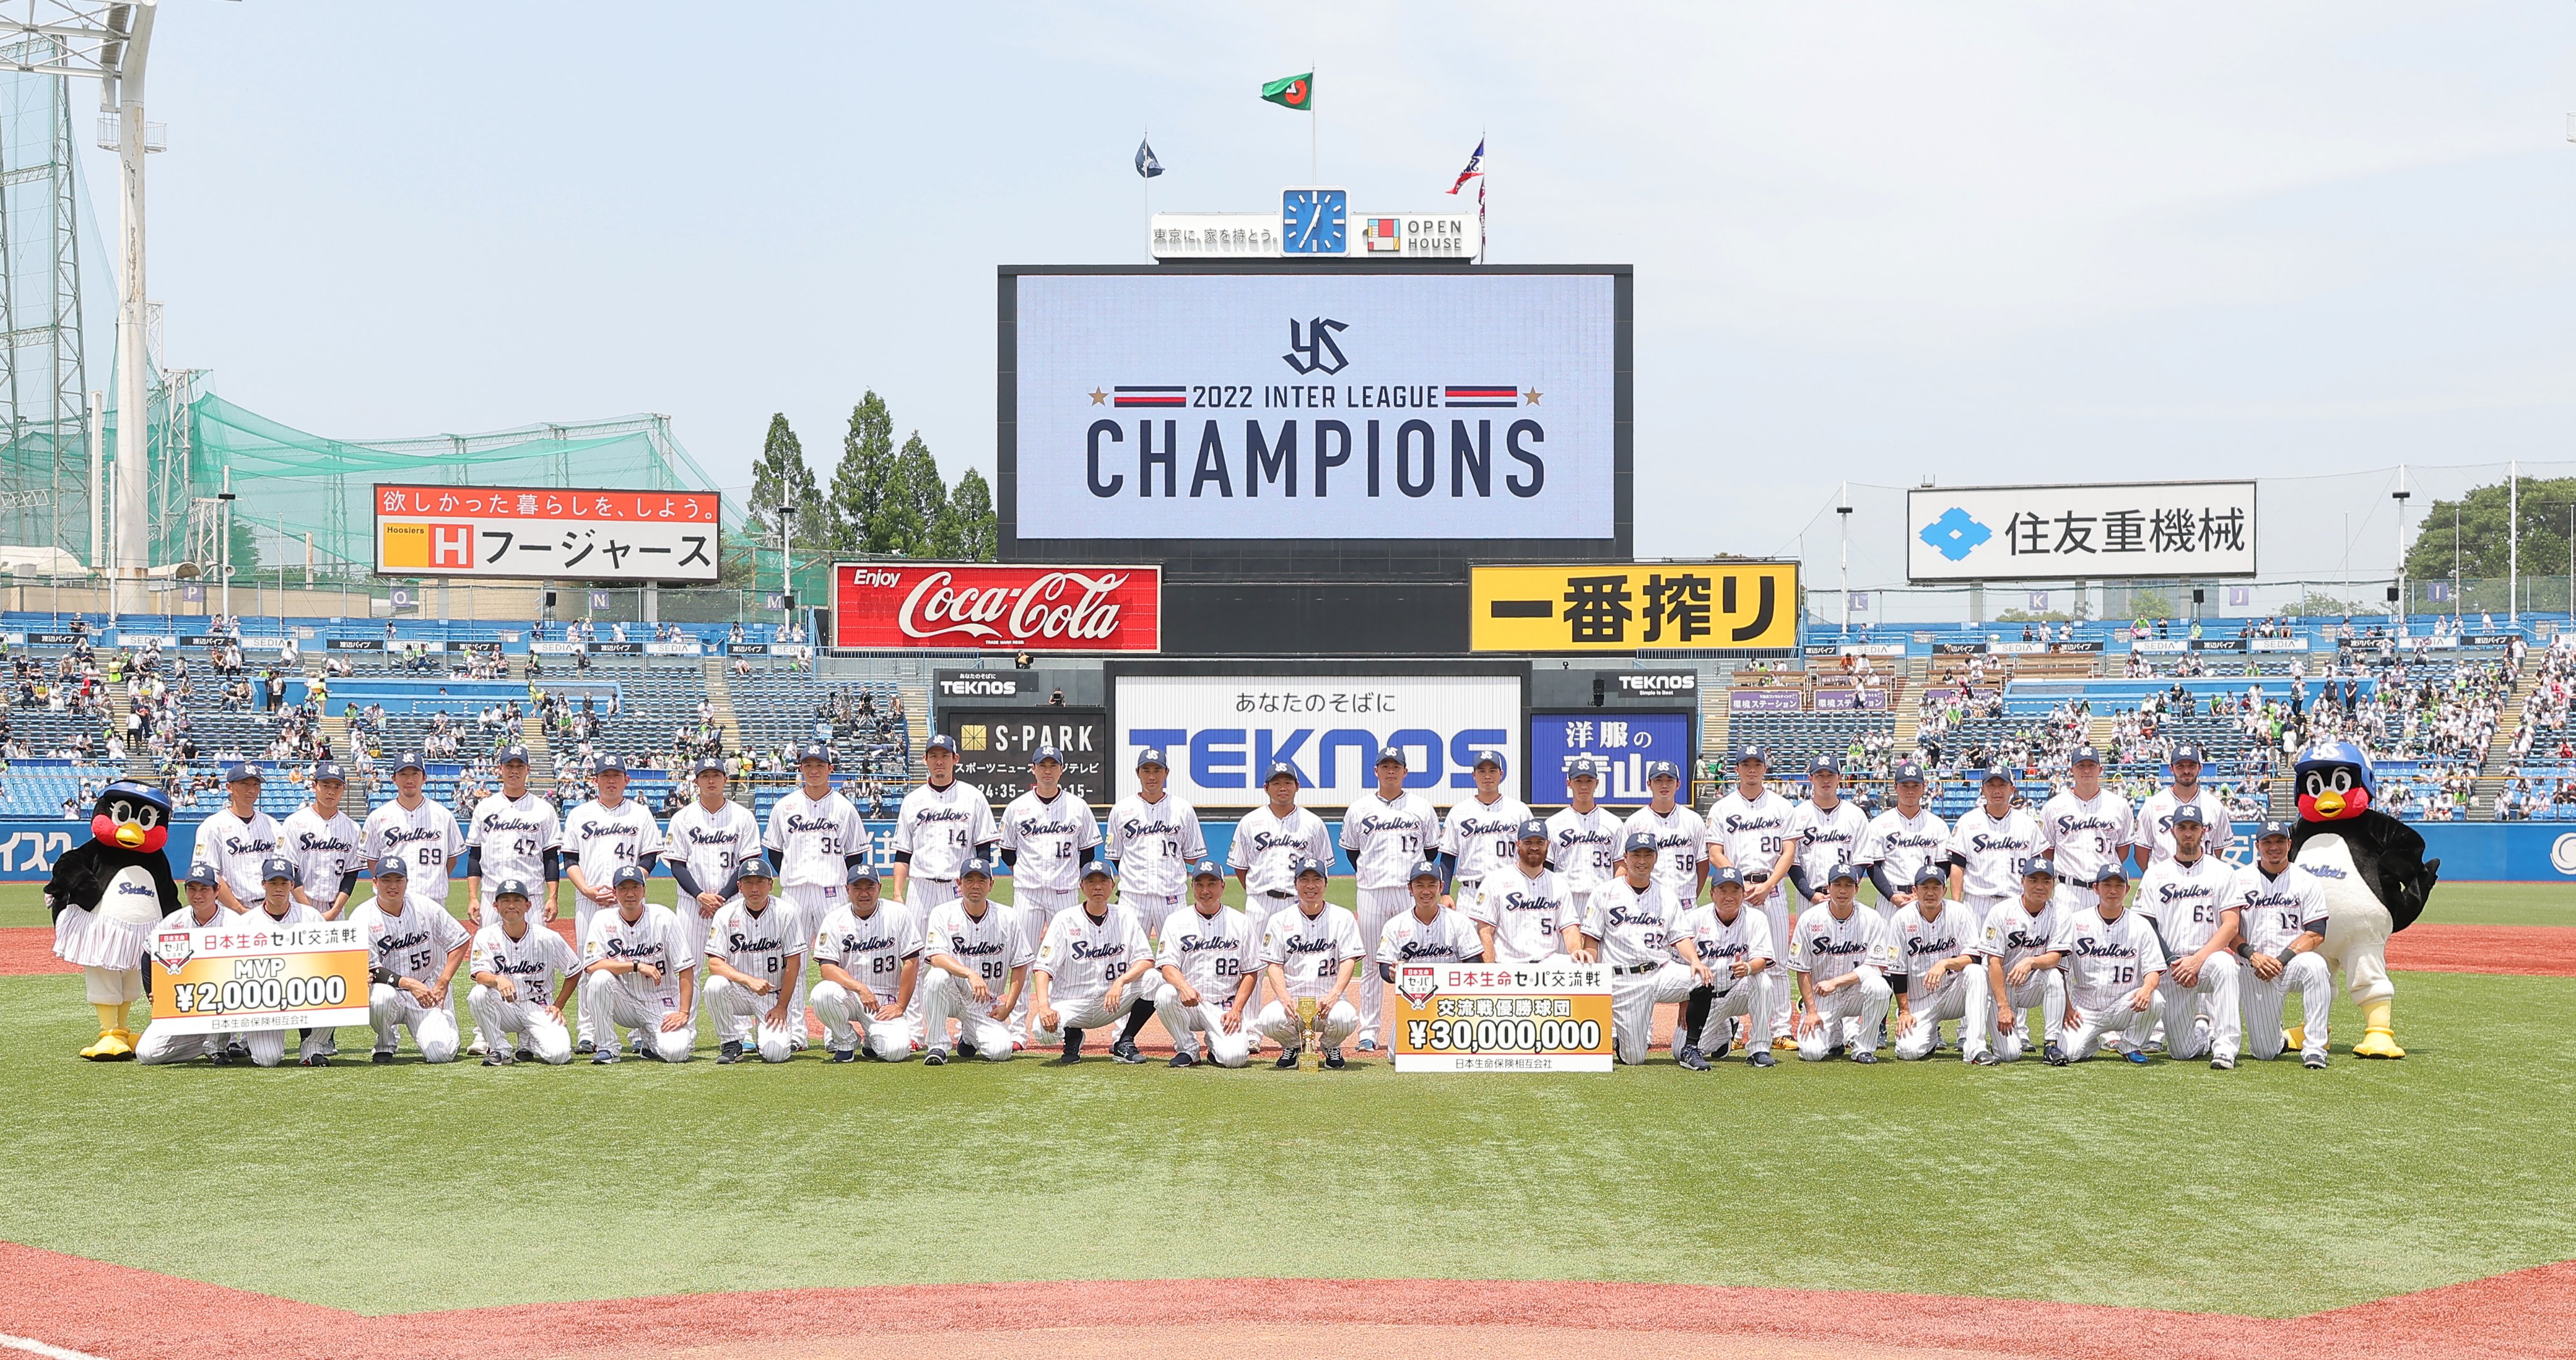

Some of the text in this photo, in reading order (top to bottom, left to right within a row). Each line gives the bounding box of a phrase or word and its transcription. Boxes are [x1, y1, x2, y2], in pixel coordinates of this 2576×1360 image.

[1153, 227, 1277, 243] 東京に、家を持とう。
[1408, 220, 1461, 233] OPEN
[1408, 238, 1461, 250] HOUSE
[1193, 386, 1438, 408] 2022 INTER LEAGUE
[1087, 419, 1545, 498] CHAMPIONS
[382, 490, 713, 520] 欲しかった暮らしを、しよう。
[387, 526, 425, 534] Hoosiers
[2005, 507, 2246, 556] 住友重機械
[435, 527, 468, 564] H
[482, 528, 711, 569] フージャース
[854, 569, 901, 588] Enjoy
[187, 586, 197, 599] P
[394, 591, 406, 605] O
[594, 593, 606, 607] N
[769, 595, 782, 607] M
[2033, 595, 2043, 608] K
[2235, 590, 2243, 603] J
[897, 571, 1130, 640] Coca-Cola
[1491, 573, 1775, 643] 一番搾り
[1854, 596, 1863, 609] L
[940, 681, 1016, 694] TEKNOS
[1618, 675, 1695, 689] TEKNOS
[1236, 693, 1396, 713] あなたのそばに
[1733, 700, 1797, 708] 環境ステーション
[996, 725, 1093, 752] S-PARK
[1565, 721, 1652, 748] 洋服の
[1129, 728, 1507, 789] TEKNOS
[483, 814, 539, 833] Swallows
[787, 814, 839, 834] Swallows
[916, 808, 969, 827] Swallows
[1362, 815, 1419, 836] Swallows
[1726, 815, 1780, 834] Swallows
[2057, 815, 2114, 836] Swallows
[581, 821, 638, 840] Swallows
[689, 827, 739, 844] Swallows
[1020, 818, 1076, 837] Swallows
[1123, 819, 1180, 840] Swallows
[1460, 818, 1519, 839] Swallows
[299, 832, 352, 854] Swallows
[384, 827, 441, 848] Swallows
[948, 829, 968, 847] 14
[1254, 832, 1309, 852] Swallows
[1401, 835, 1418, 854] 17
[1558, 828, 1613, 850] Swallows
[1760, 836, 1783, 853] 20
[1886, 831, 1939, 850] Swallows
[1972, 834, 2029, 853] Swallows
[2094, 837, 2115, 854] 37
[513, 839, 536, 856] 47
[614, 842, 635, 862] 44
[1055, 842, 1072, 859] 12
[1496, 840, 1516, 858] 00
[419, 848, 441, 867] 69
[1592, 850, 1612, 868] 33
[1675, 854, 1694, 872] 58
[2010, 857, 2027, 877] 19
[334, 859, 346, 876] 3
[1506, 892, 1561, 911] Swallows
[2245, 890, 2300, 910] Swallows
[1609, 906, 1663, 928] Swallows
[2193, 905, 2214, 923] 63
[1541, 918, 1558, 935] 5
[377, 930, 431, 957] Swallows
[606, 938, 665, 960] Swallows
[841, 934, 896, 954] Swallows
[952, 936, 1005, 956] Swallows
[1072, 940, 1126, 962] Swallows
[1180, 935, 1240, 953] Swallows
[1401, 941, 1455, 961] Swallows
[1811, 936, 1867, 957] Swallows
[2075, 937, 2136, 961] Swallows
[235, 958, 286, 979] MVP
[409, 949, 431, 973] 55
[493, 955, 546, 975] Swallows
[873, 954, 897, 975] 83
[981, 961, 1004, 980] 98
[1215, 957, 1240, 977] 82
[1318, 957, 1336, 977] 22
[1105, 961, 1127, 981] 89
[2112, 966, 2134, 983] 16
[174, 975, 347, 1015] ¥2,000,000
[1438, 999, 1571, 1017] 交流戦優勝球団
[211, 1015, 309, 1030] 日本生命保険相互会社
[1407, 1019, 1601, 1053] ¥30,000,000
[1455, 1058, 1552, 1069] 日本生命保険相互会社
